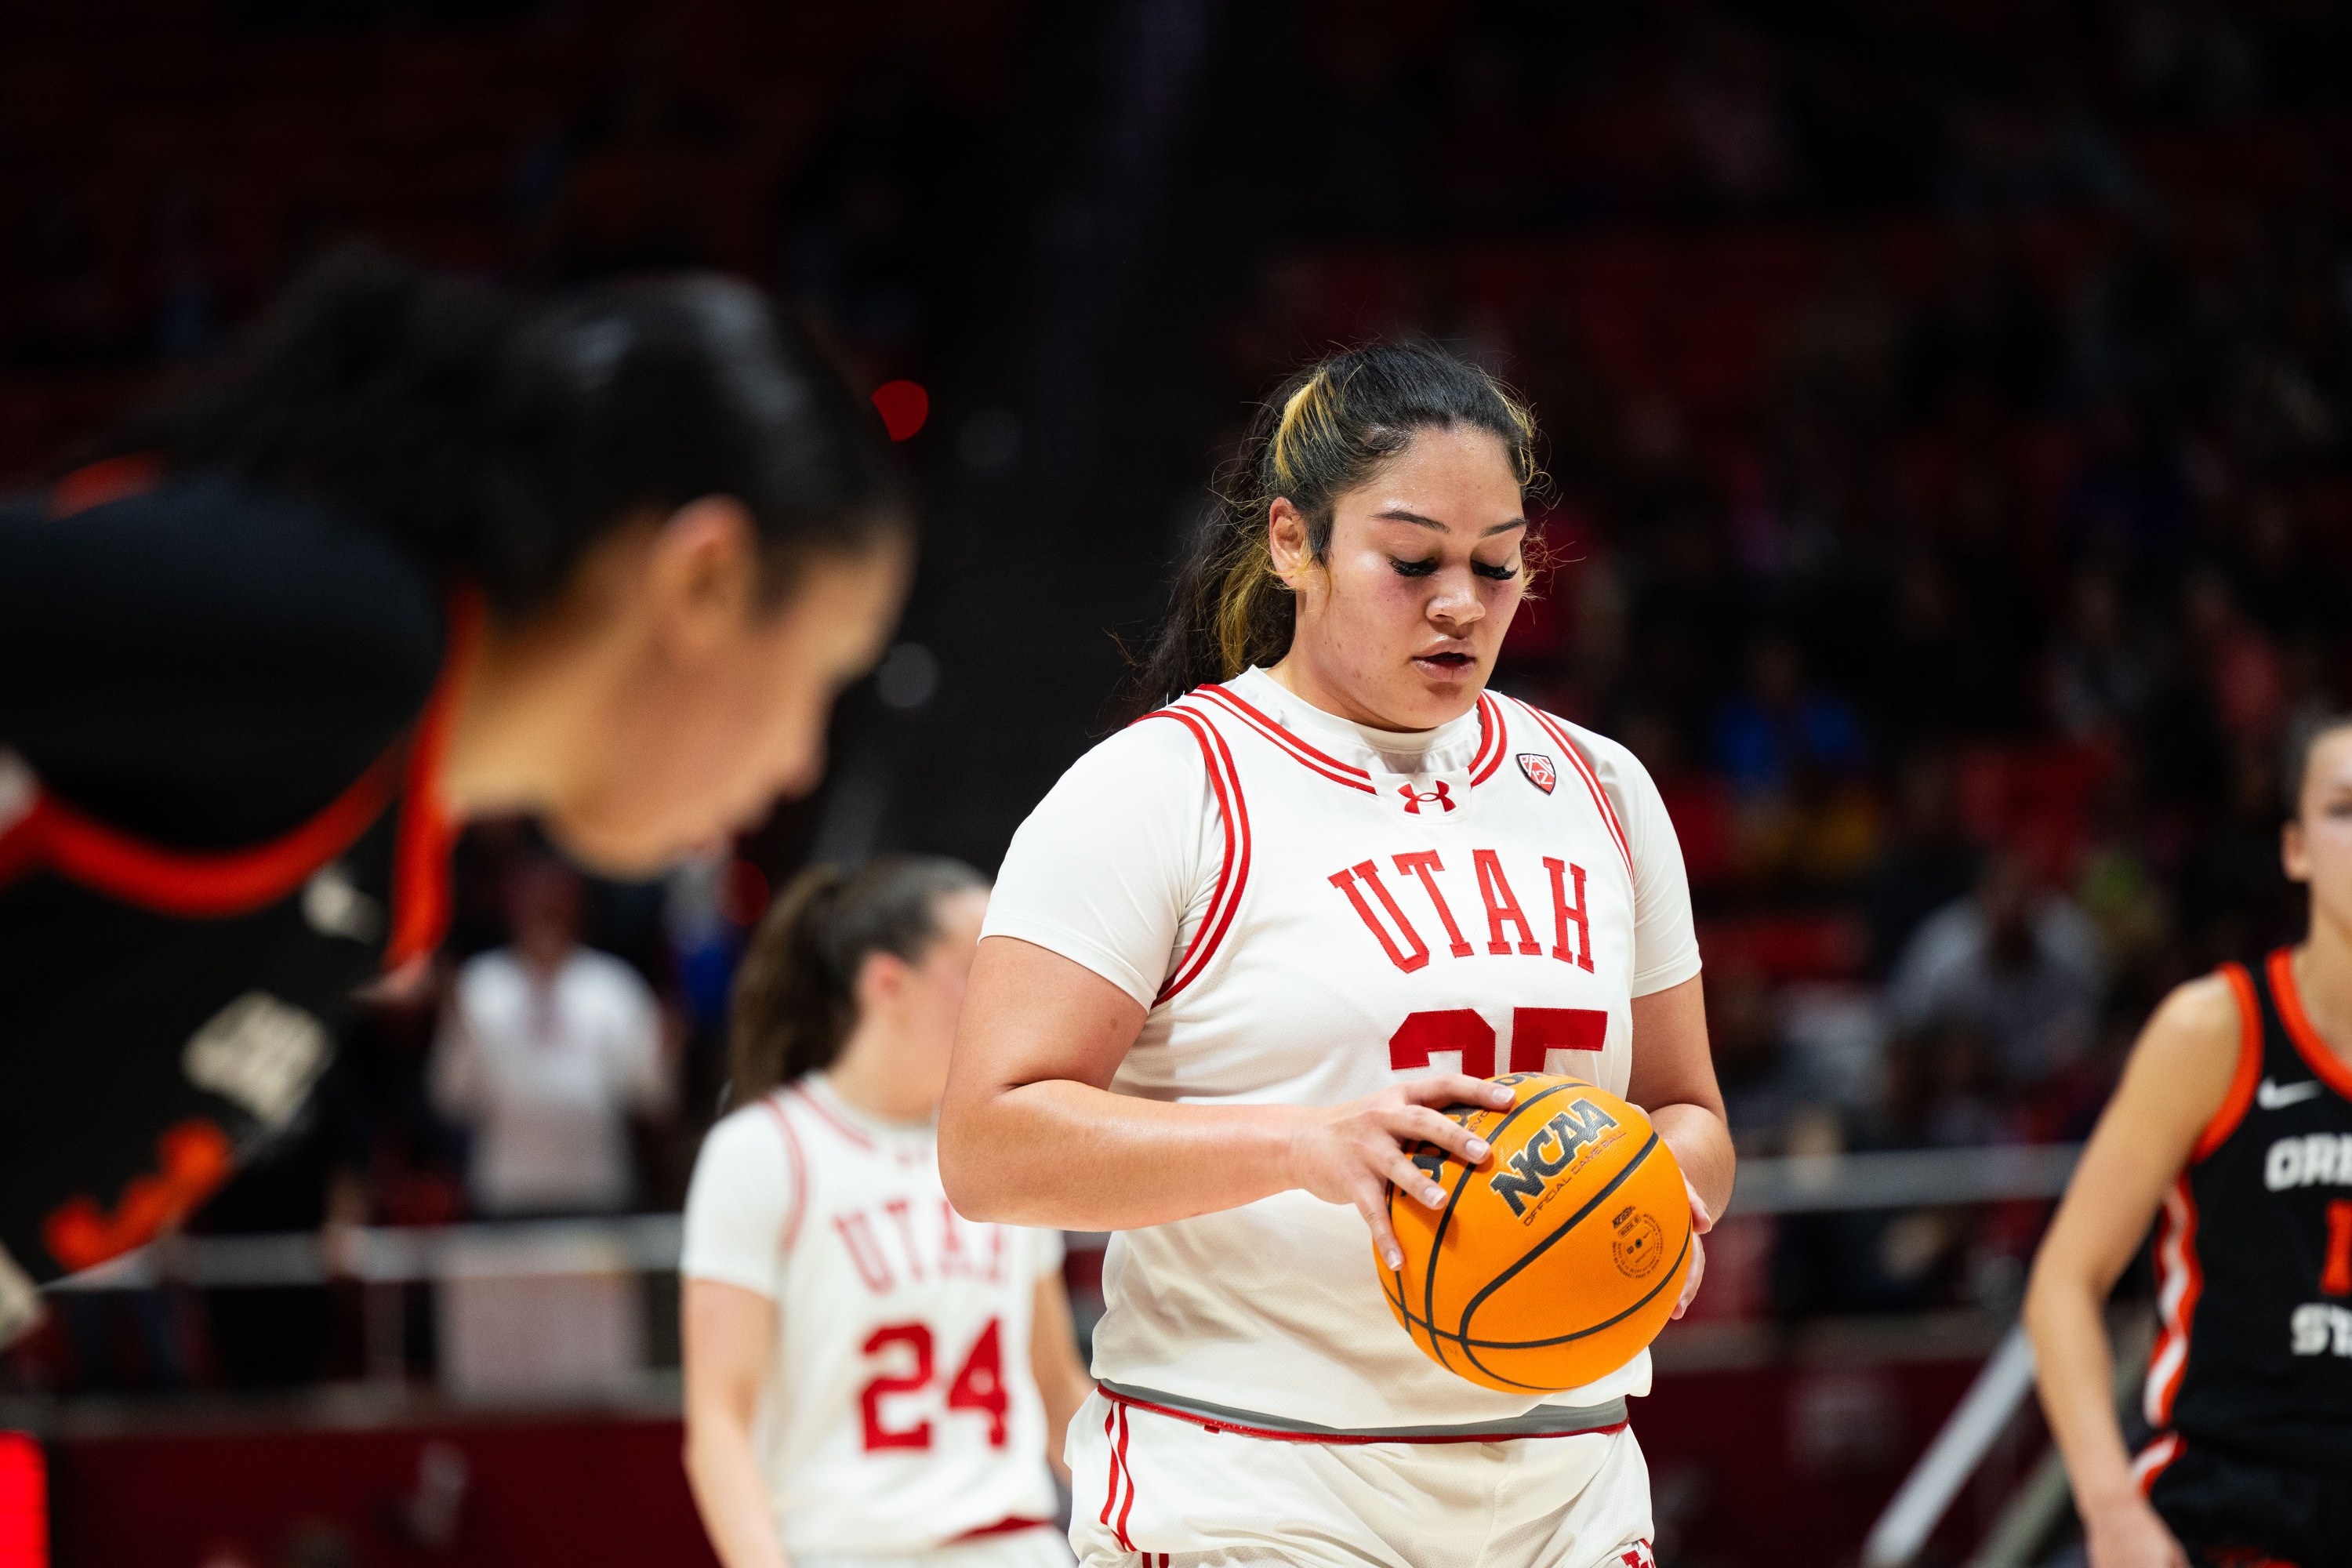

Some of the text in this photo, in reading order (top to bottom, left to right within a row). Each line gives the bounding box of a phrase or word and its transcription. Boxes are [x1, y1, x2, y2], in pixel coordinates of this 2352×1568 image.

[1518, 754, 1555, 778] PAC
[1532, 770, 1552, 784] 12
[1327, 849, 1595, 974] UTAH
[1489, 1098, 1620, 1220] NCAA
[1523, 1131, 1627, 1226] OFFICIAL GAME BALL
[859, 1316, 1009, 1454] 24
